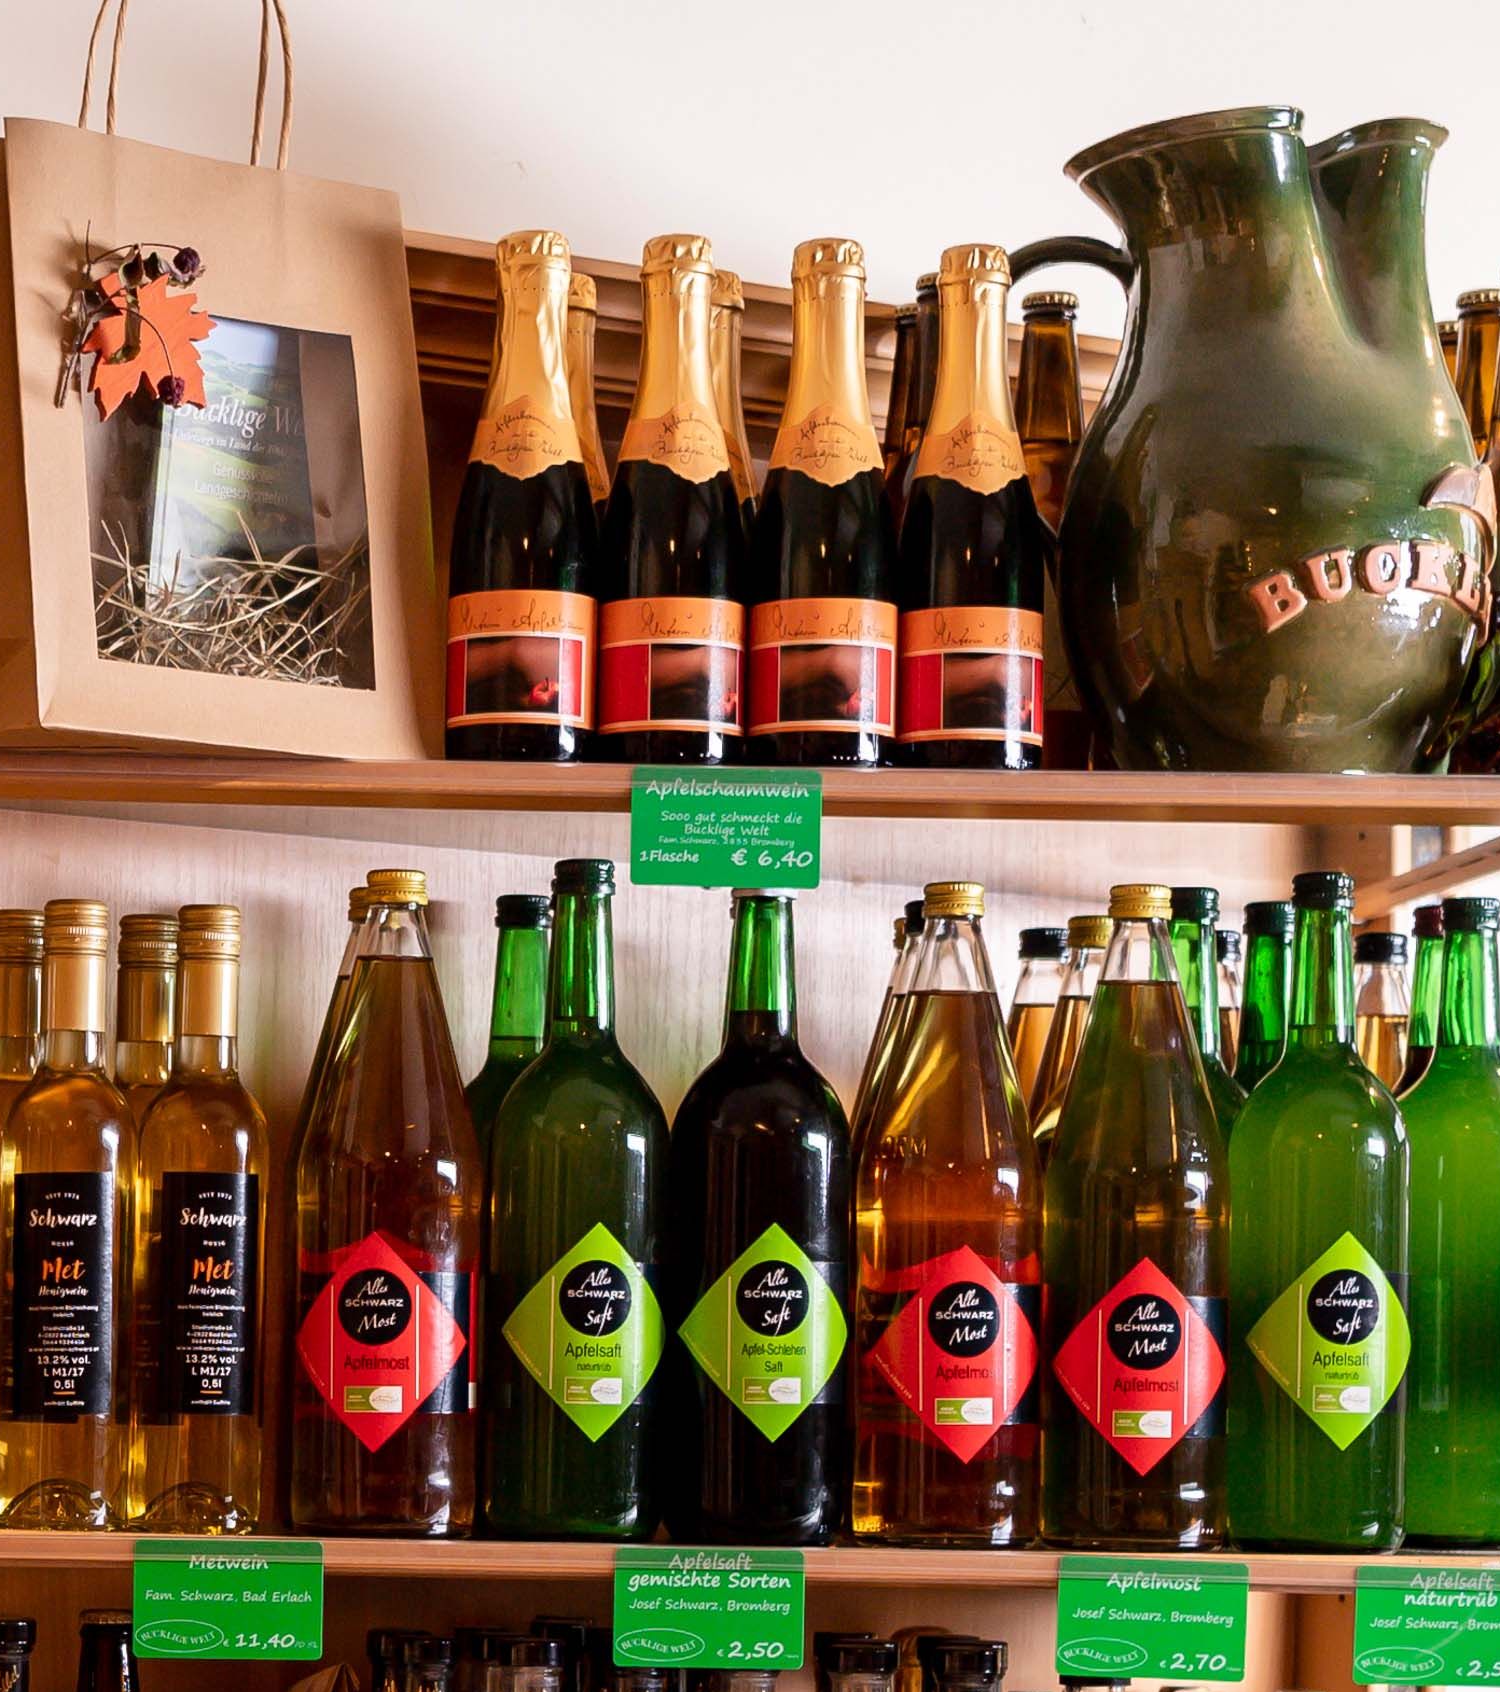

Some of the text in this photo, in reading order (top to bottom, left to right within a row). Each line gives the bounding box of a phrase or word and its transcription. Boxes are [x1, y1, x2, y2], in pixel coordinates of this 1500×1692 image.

[645, 778, 809, 800] Apfelschaumwein
[661, 811, 802, 824] Sooo gut schmeckt die
[684, 824, 770, 839] Bucklige Welt
[730, 849, 813, 869] € 6,40
[345, 1299, 404, 1307] SCHWARZ
[358, 1312, 396, 1333] Most
[565, 1342, 622, 1359] Apfelsaft
[742, 1343, 806, 1357] Apfel-Schlehen
[189, 1554, 269, 1571] Metwein
[668, 1552, 752, 1574] Apfelsaft
[628, 1572, 791, 1592] gemischte Sorten
[1107, 1571, 1202, 1594] Apfelmost
[1410, 1571, 1495, 1593] Apfelsaft
[243, 1591, 266, 1602] Bad
[272, 1591, 312, 1603] Erlach
[629, 1597, 662, 1610] Josef
[727, 1599, 790, 1615] Bromberg
[1404, 1591, 1498, 1608] naturtrüb
[728, 1641, 784, 1660] 2,50
[1170, 1653, 1226, 1672] 2,70
